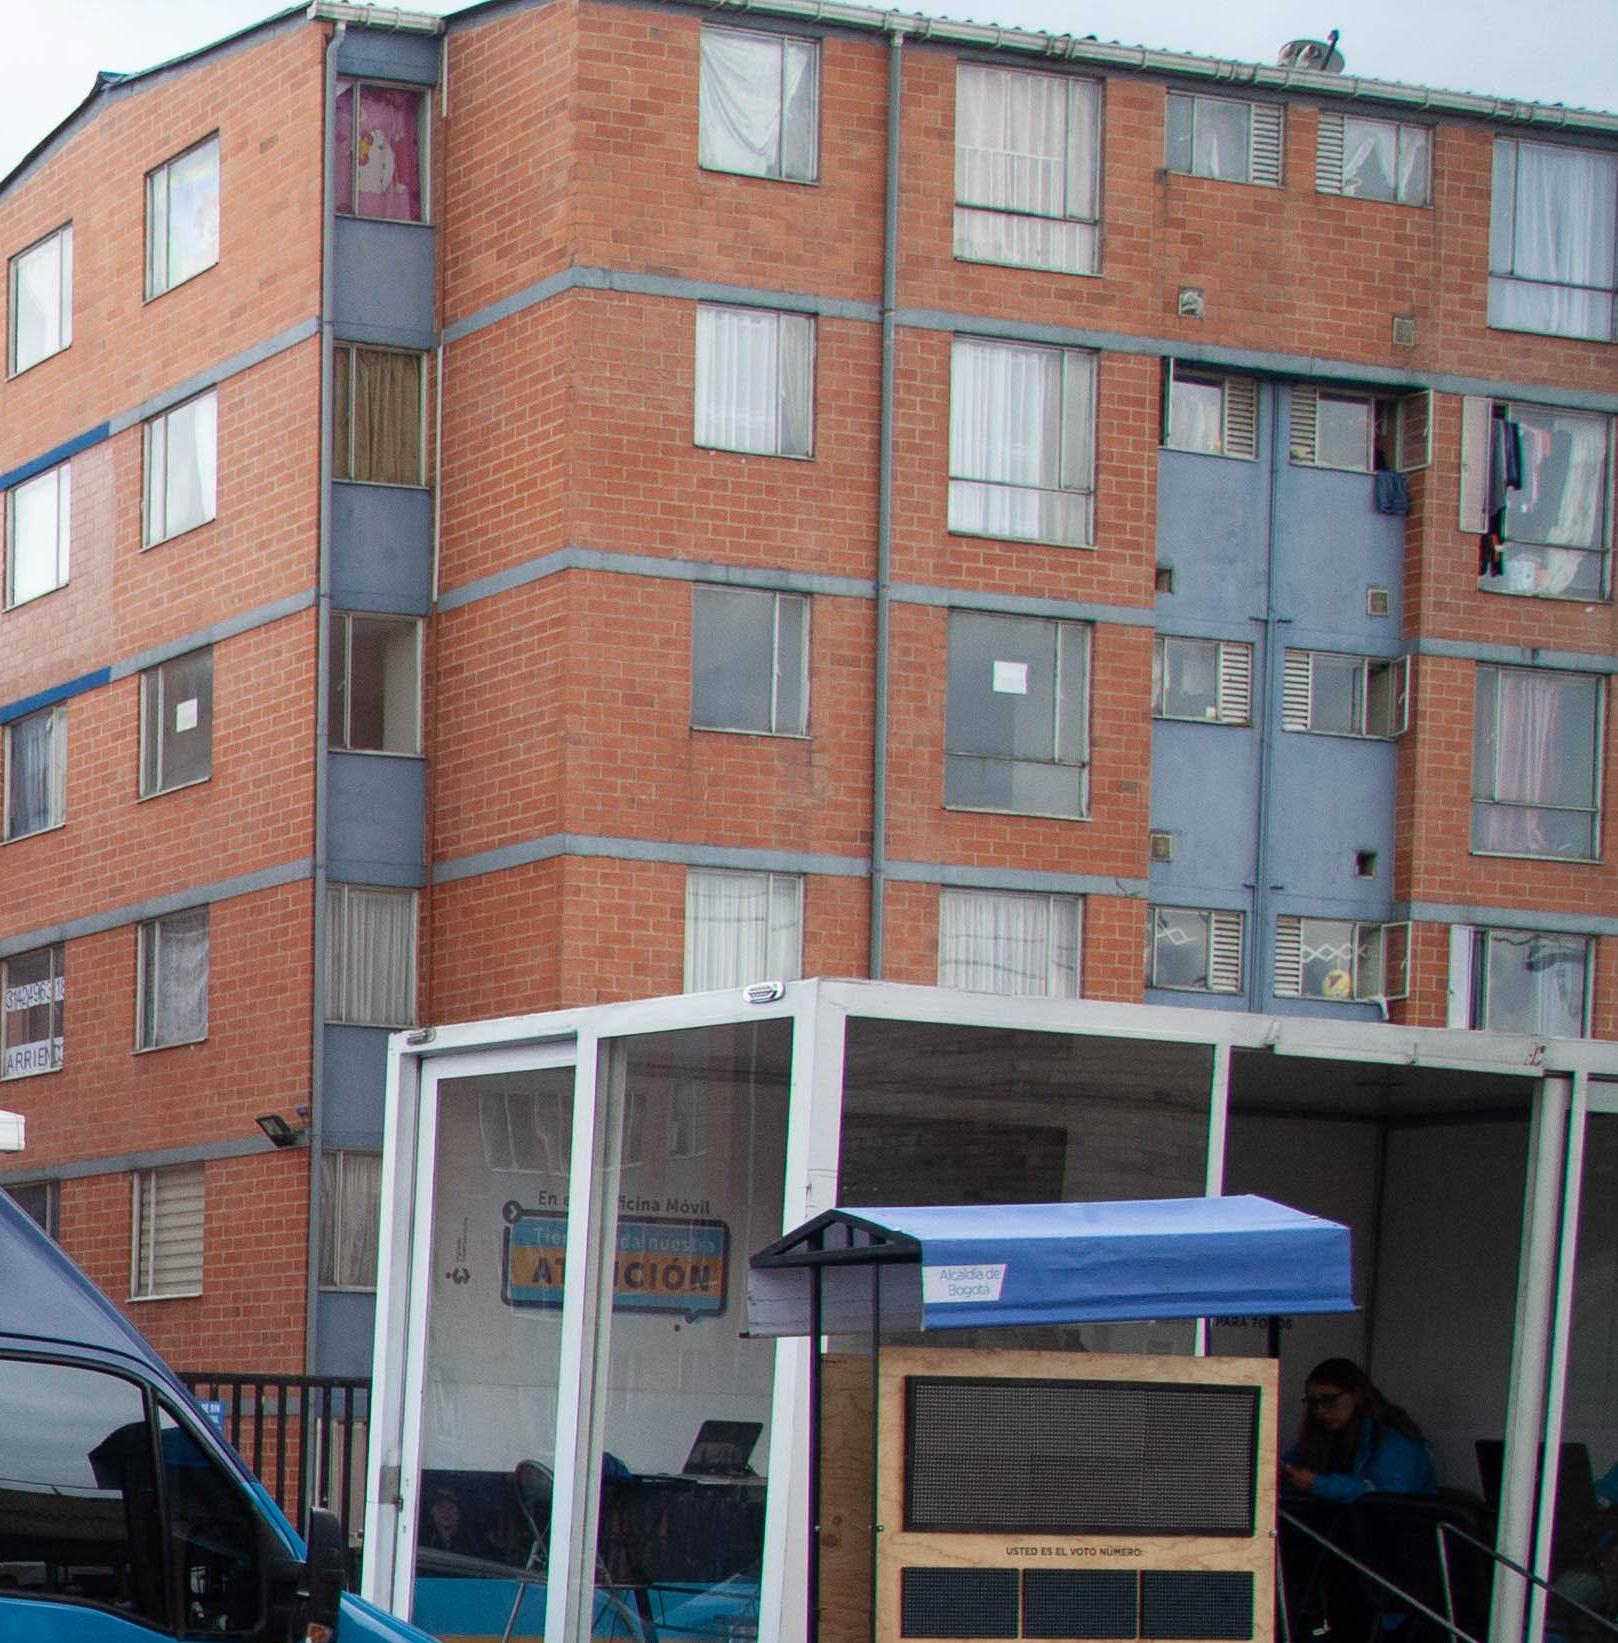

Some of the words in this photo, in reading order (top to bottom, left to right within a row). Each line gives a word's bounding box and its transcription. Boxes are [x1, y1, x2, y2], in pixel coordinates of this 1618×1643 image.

[619, 1196, 660, 1212] icina
[1251, 1317, 1293, 1330] TOOS
[1006, 1547, 1037, 1556] USTED
[1041, 1547, 1052, 1556] ES
[1056, 1547, 1067, 1556] EL
[1070, 1548, 1097, 1556] VOTO
